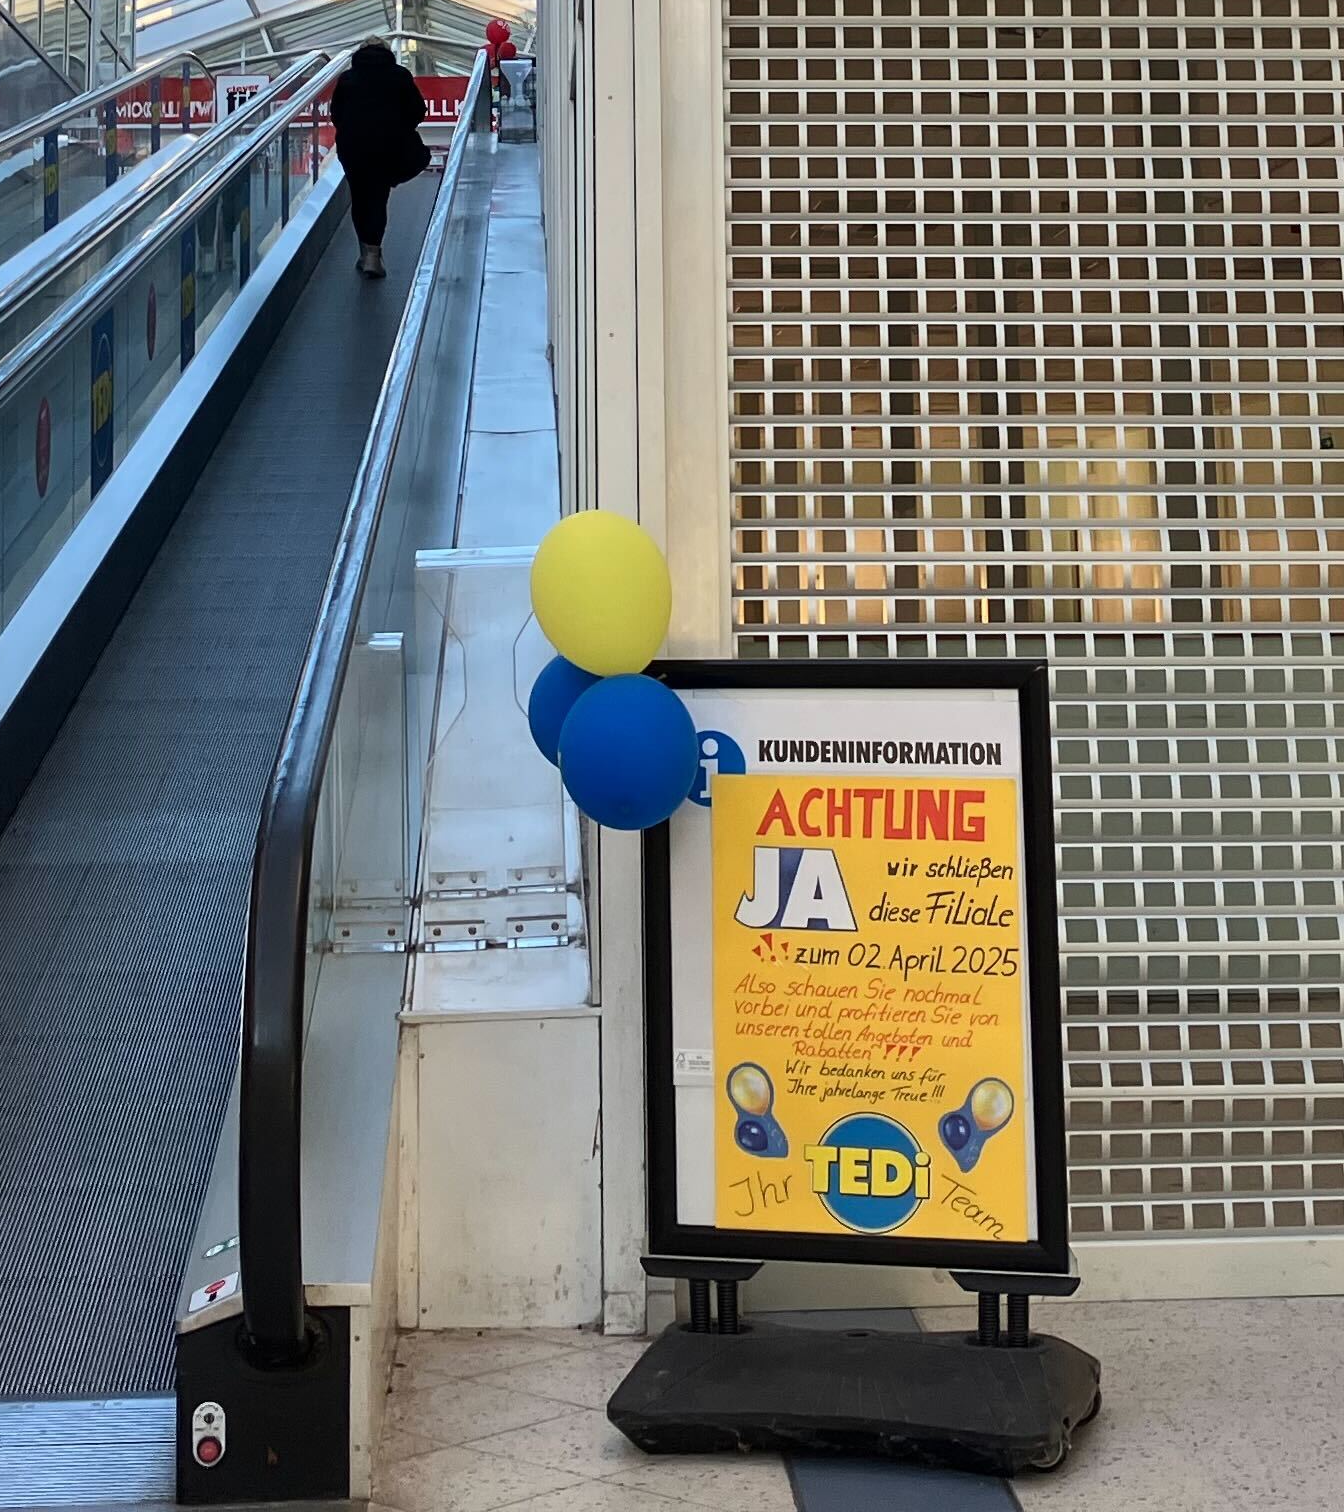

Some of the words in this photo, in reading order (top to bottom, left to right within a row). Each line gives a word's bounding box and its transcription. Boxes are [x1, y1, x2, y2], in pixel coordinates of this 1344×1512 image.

[758, 739, 1002, 766] KUNDENINFORMATION
[756, 787, 986, 842] ACHTUNG
[734, 845, 858, 931] JA
[868, 891, 921, 923] diese
[794, 946, 840, 966] zum
[951, 945, 1019, 977] 2025
[784, 974, 858, 999] schauen
[865, 978, 896, 1001] Sie
[734, 998, 789, 1016] vorbei
[794, 1000, 833, 1019] und
[837, 1003, 926, 1025] profitieren
[931, 1006, 962, 1026] Sie
[969, 1011, 999, 1027] von
[735, 1020, 799, 1038] unseren
[802, 1020, 851, 1041] tollen
[855, 1025, 933, 1048] Angeboten
[941, 1030, 973, 1048] und
[792, 1041, 872, 1060] Rabatten
[784, 1059, 812, 1075] Wir
[819, 1060, 886, 1080] bedanken
[890, 1070, 915, 1082] uns
[919, 1068, 947, 1085] für
[819, 1080, 886, 1105] jahrelange
[804, 1143, 931, 1200] TEDi
[940, 1173, 1005, 1240] Team
